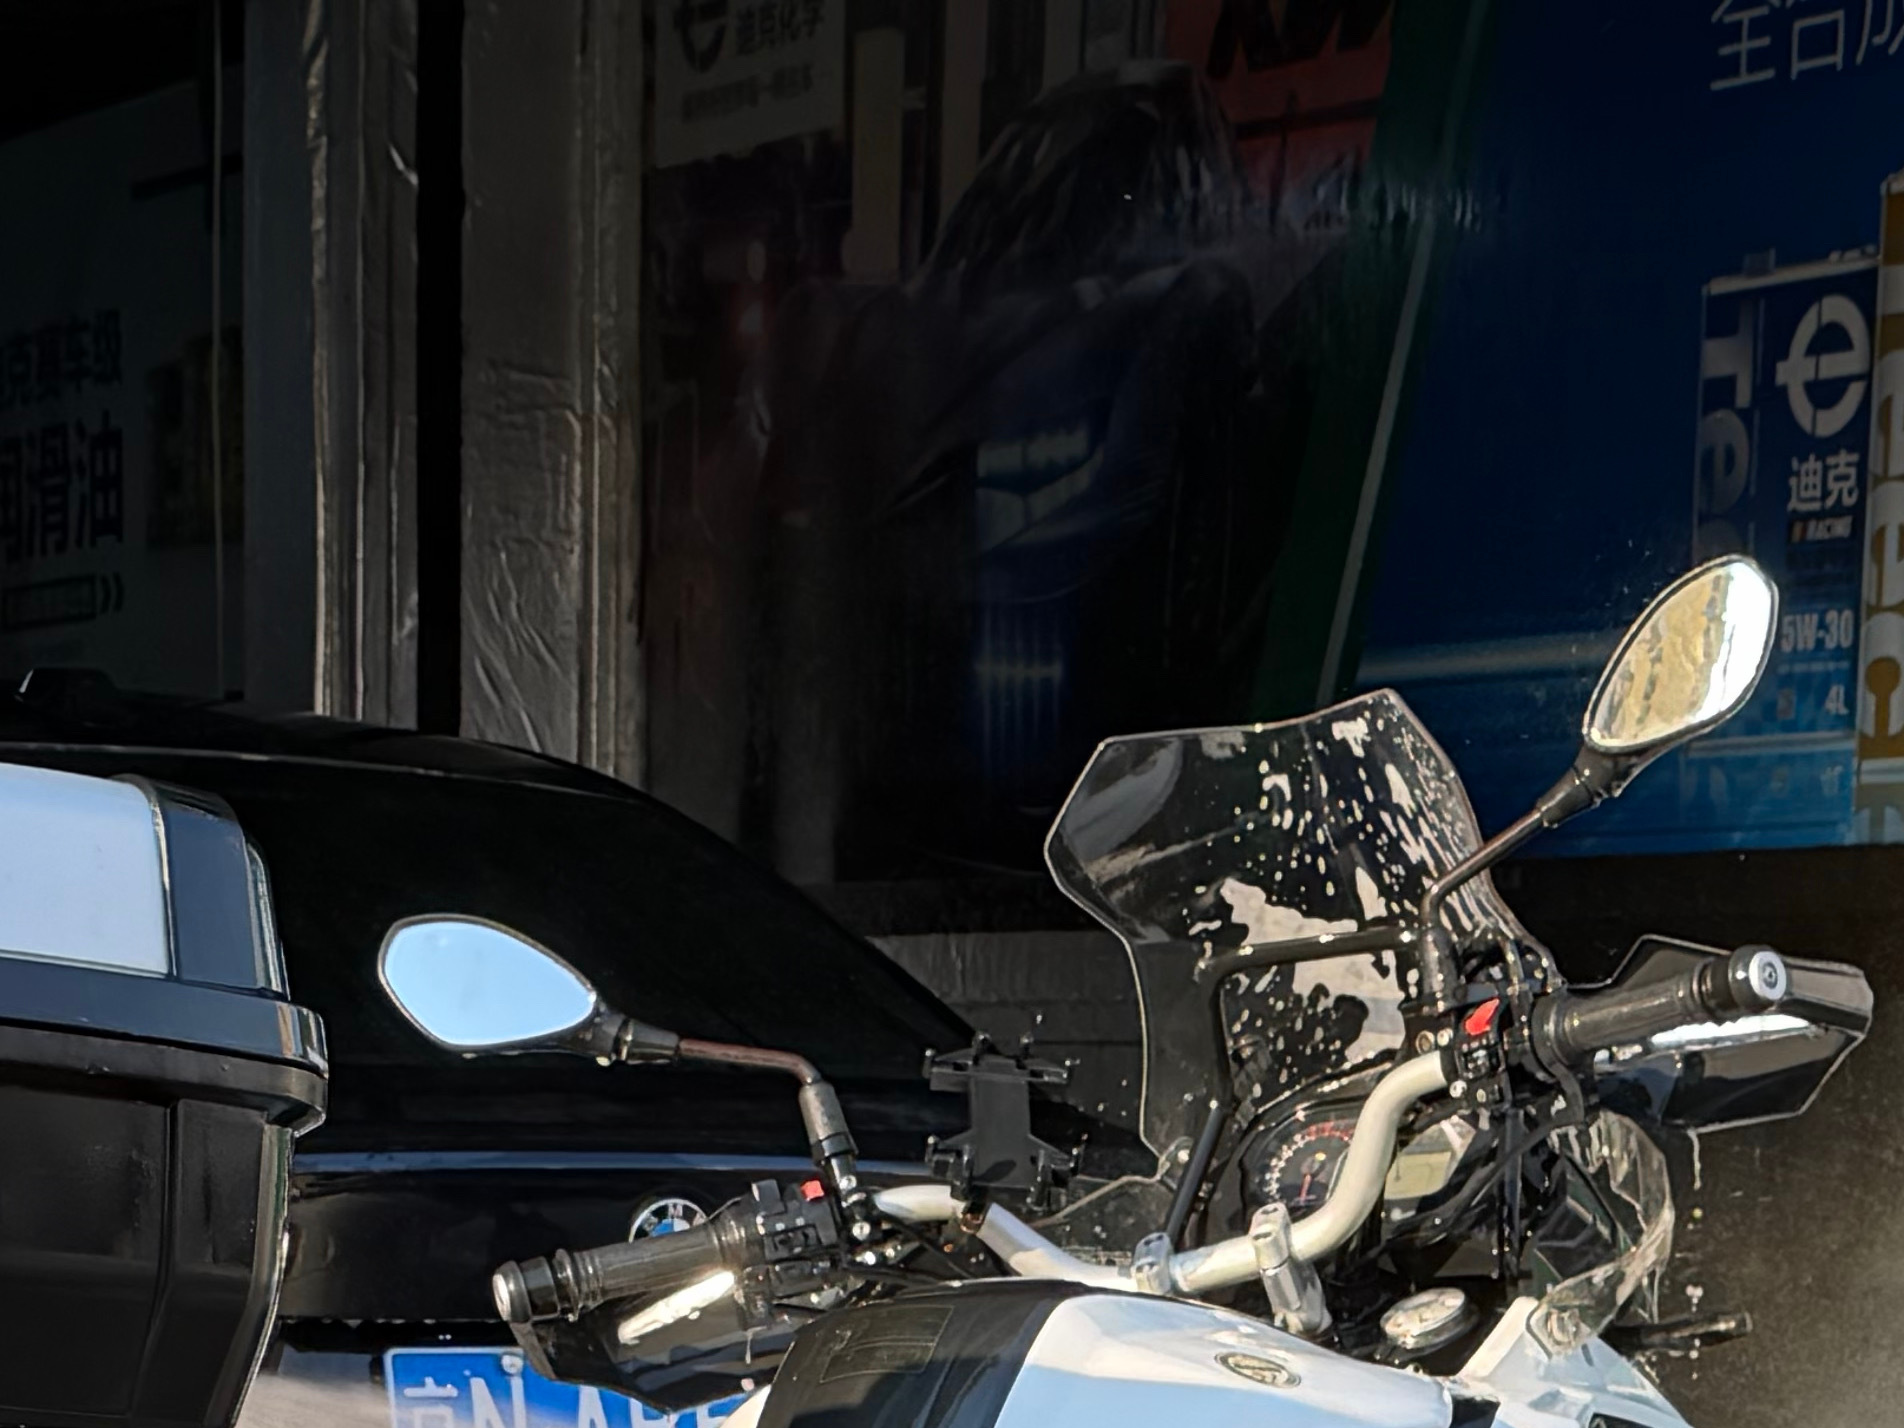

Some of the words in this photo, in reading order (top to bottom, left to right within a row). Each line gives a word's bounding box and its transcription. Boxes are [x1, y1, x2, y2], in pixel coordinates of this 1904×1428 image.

[1786, 449, 1860, 513] 迪克
[1780, 608, 1854, 653] 5W-30
[1824, 683, 1849, 716] 4L
